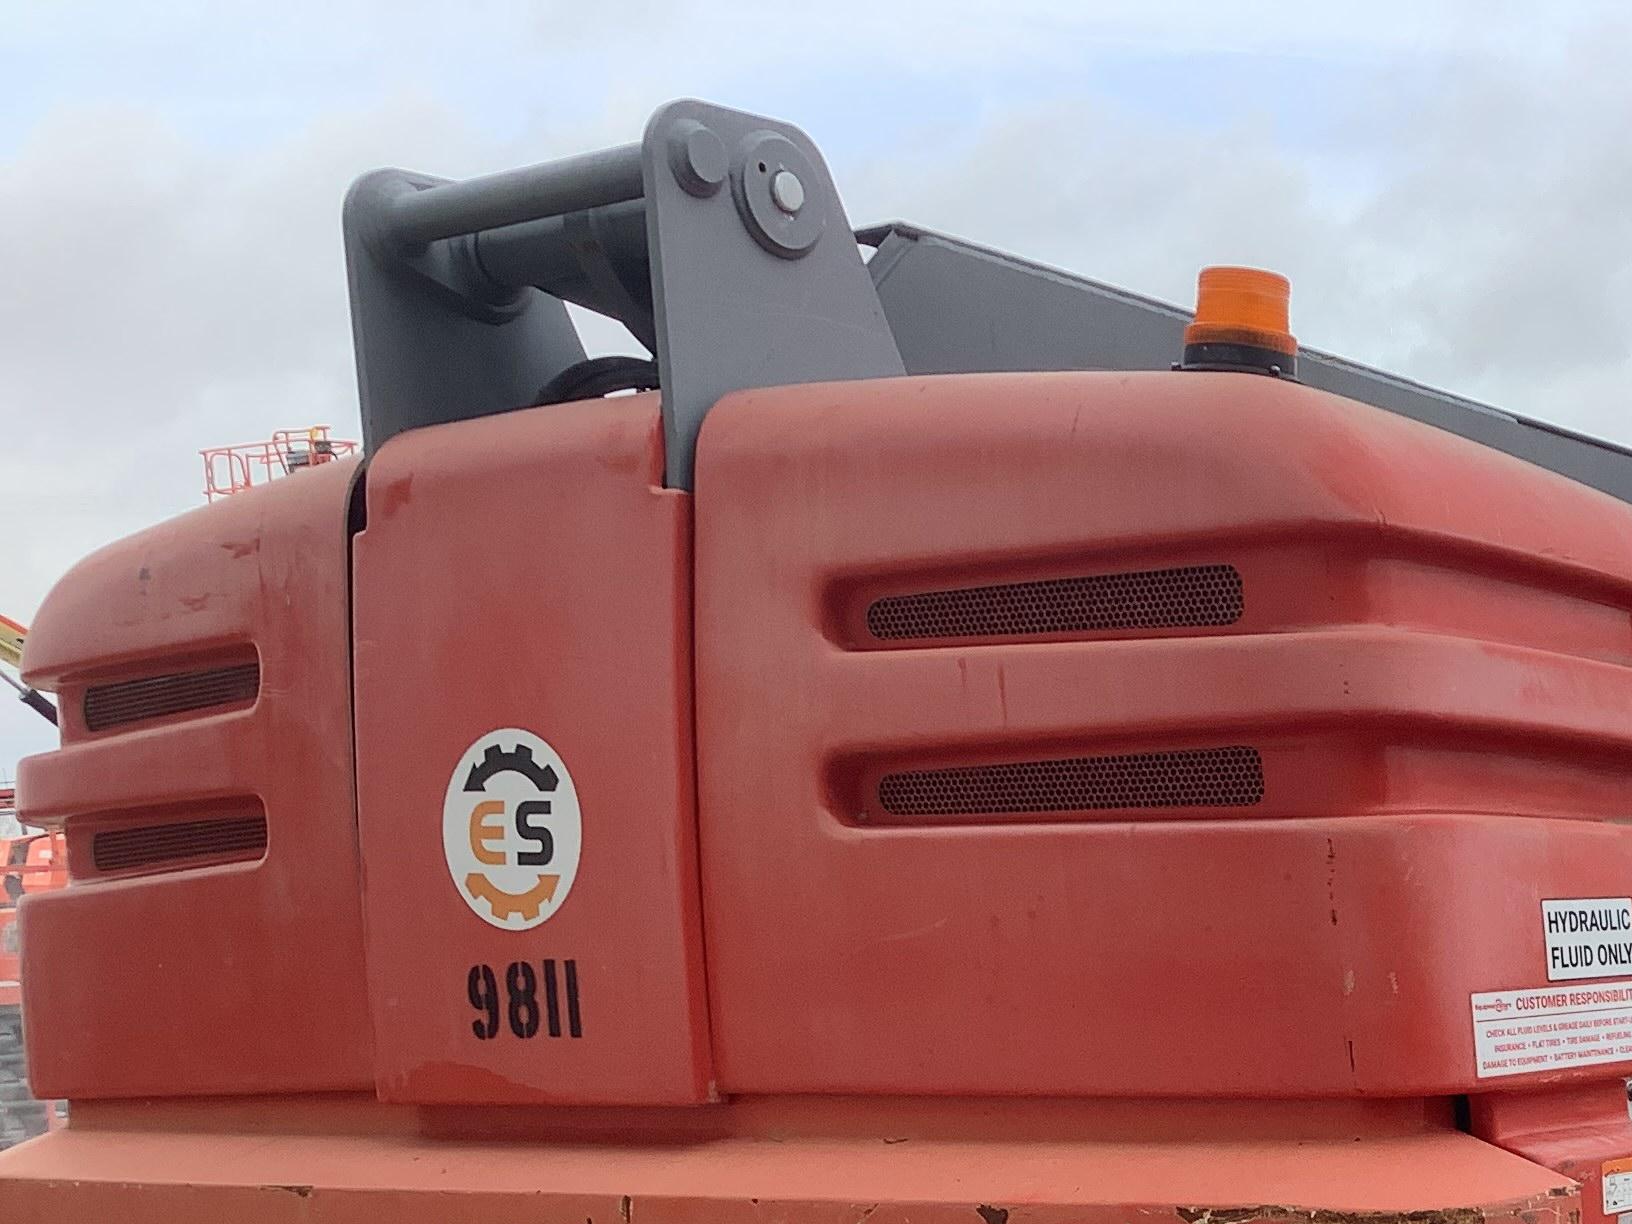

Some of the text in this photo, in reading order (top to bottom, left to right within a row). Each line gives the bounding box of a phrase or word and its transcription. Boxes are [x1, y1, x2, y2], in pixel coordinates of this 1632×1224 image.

[469, 800, 554, 866] ES
[1548, 909, 1631, 933] HYDRAULIC
[1551, 943, 1632, 968] FLUID ONLY
[467, 959, 582, 1041] 9811
[1516, 994, 1568, 1010] CUSTOMER
